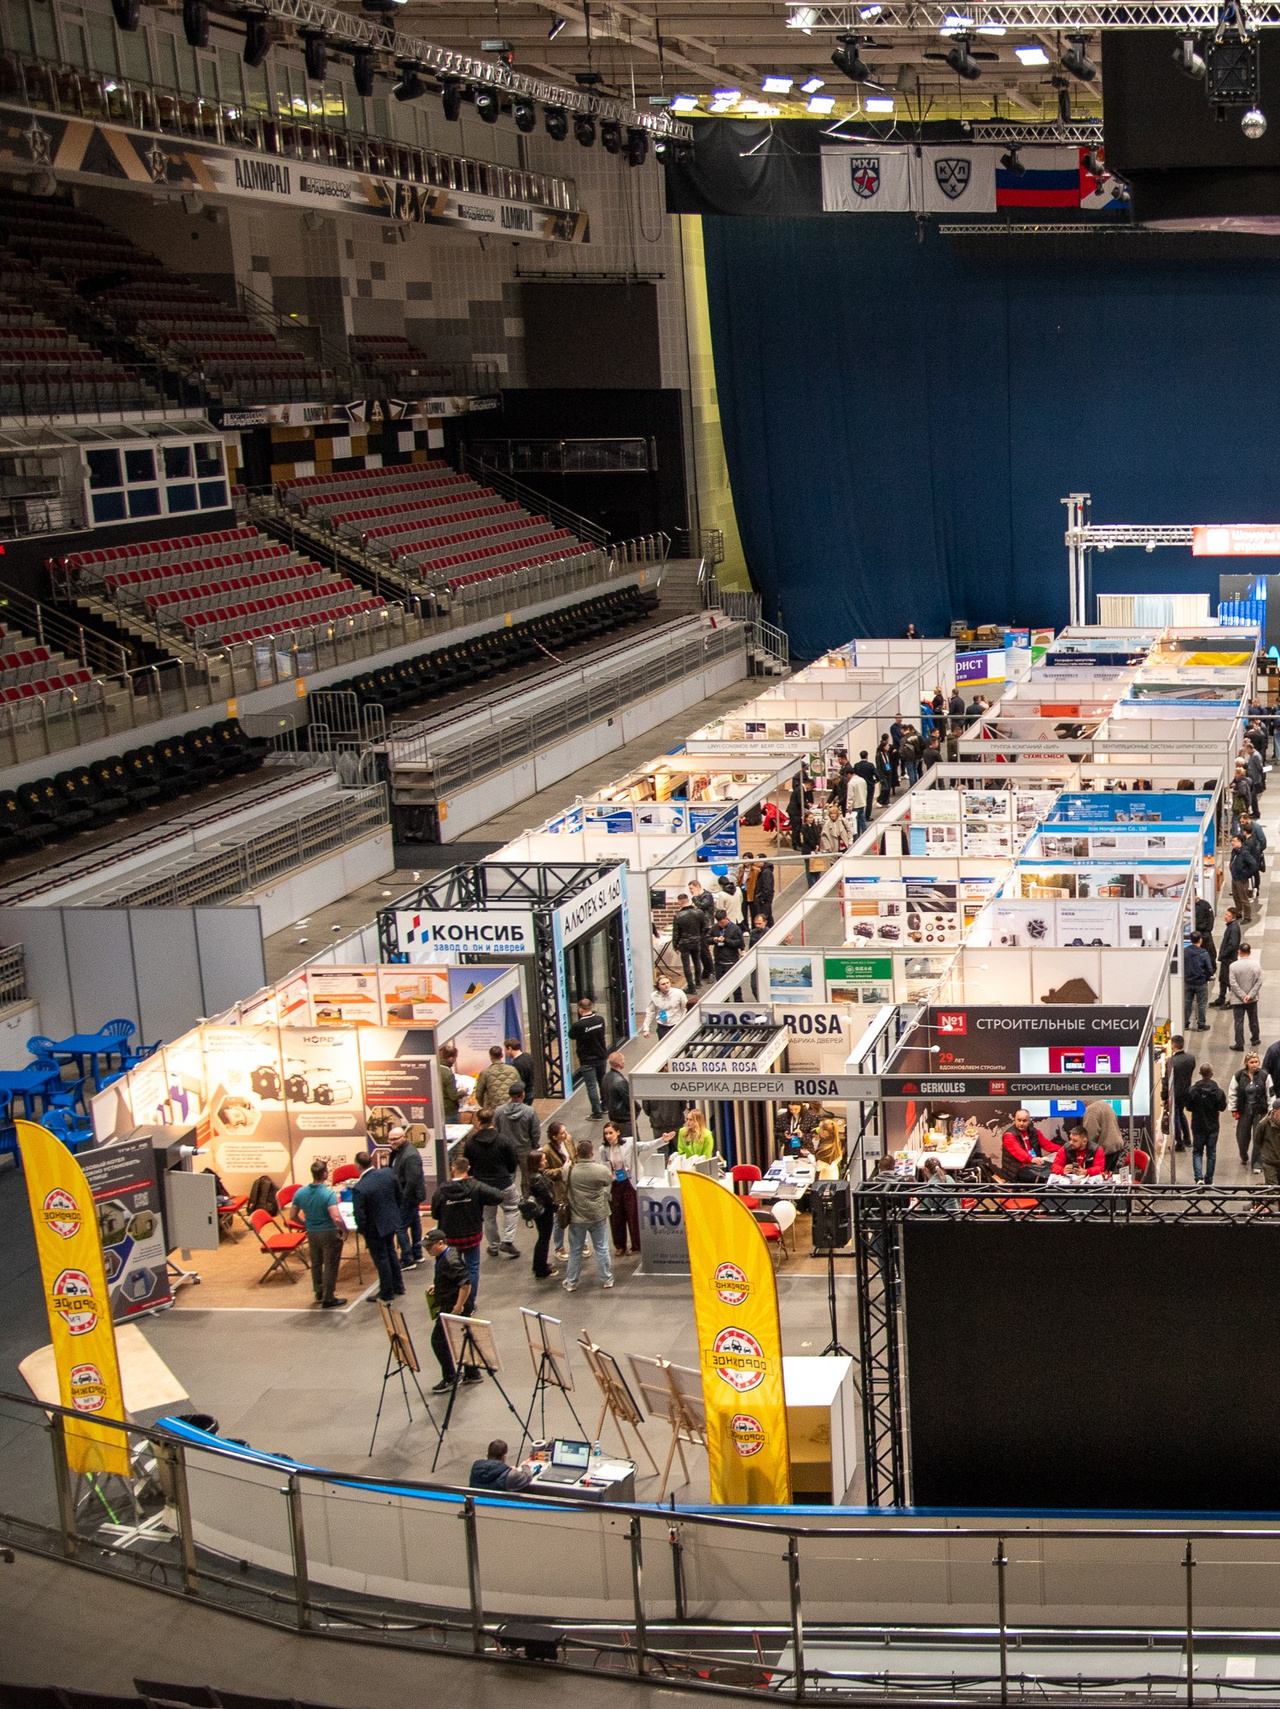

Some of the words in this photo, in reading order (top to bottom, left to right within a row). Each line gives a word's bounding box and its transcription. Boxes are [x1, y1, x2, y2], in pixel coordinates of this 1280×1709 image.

[852, 159, 879, 169] МХЛ
[234, 158, 291, 195] АДМИРАЛ
[307, 184, 351, 199] ВЛАДИВОСТОК
[564, 894, 598, 936] АЛЮТЕХ
[432, 924, 524, 941] КОНСИБ
[434, 944, 460, 953] завод
[463, 944, 484, 952] оон
[485, 944, 491, 952] и
[493, 942, 525, 953] дверей
[783, 1013, 843, 1035] ROSA
[941, 1015, 963, 1027] №1
[976, 1018, 1086, 1031] СТРОИТЕЛЬНЫЕ
[1091, 1018, 1140, 1031] СМЕСИ
[816, 1036, 844, 1045] ДВЕРЕЙ
[939, 1052, 953, 1064] 29
[671, 1061, 697, 1073] ROSA
[702, 1061, 727, 1073] ROSA
[732, 1061, 757, 1073] ROSA
[670, 1080, 730, 1093] ФАБРИКА
[732, 1079, 784, 1094] ДВЕРЕЙ
[794, 1079, 839, 1096] ROSA
[920, 1082, 966, 1093] GERKULES
[1011, 1082, 1080, 1092] СТРОИТЕЛЬНЫЕ
[1081, 1082, 1112, 1092] СМЕСИ
[650, 1200, 682, 1226] RO
